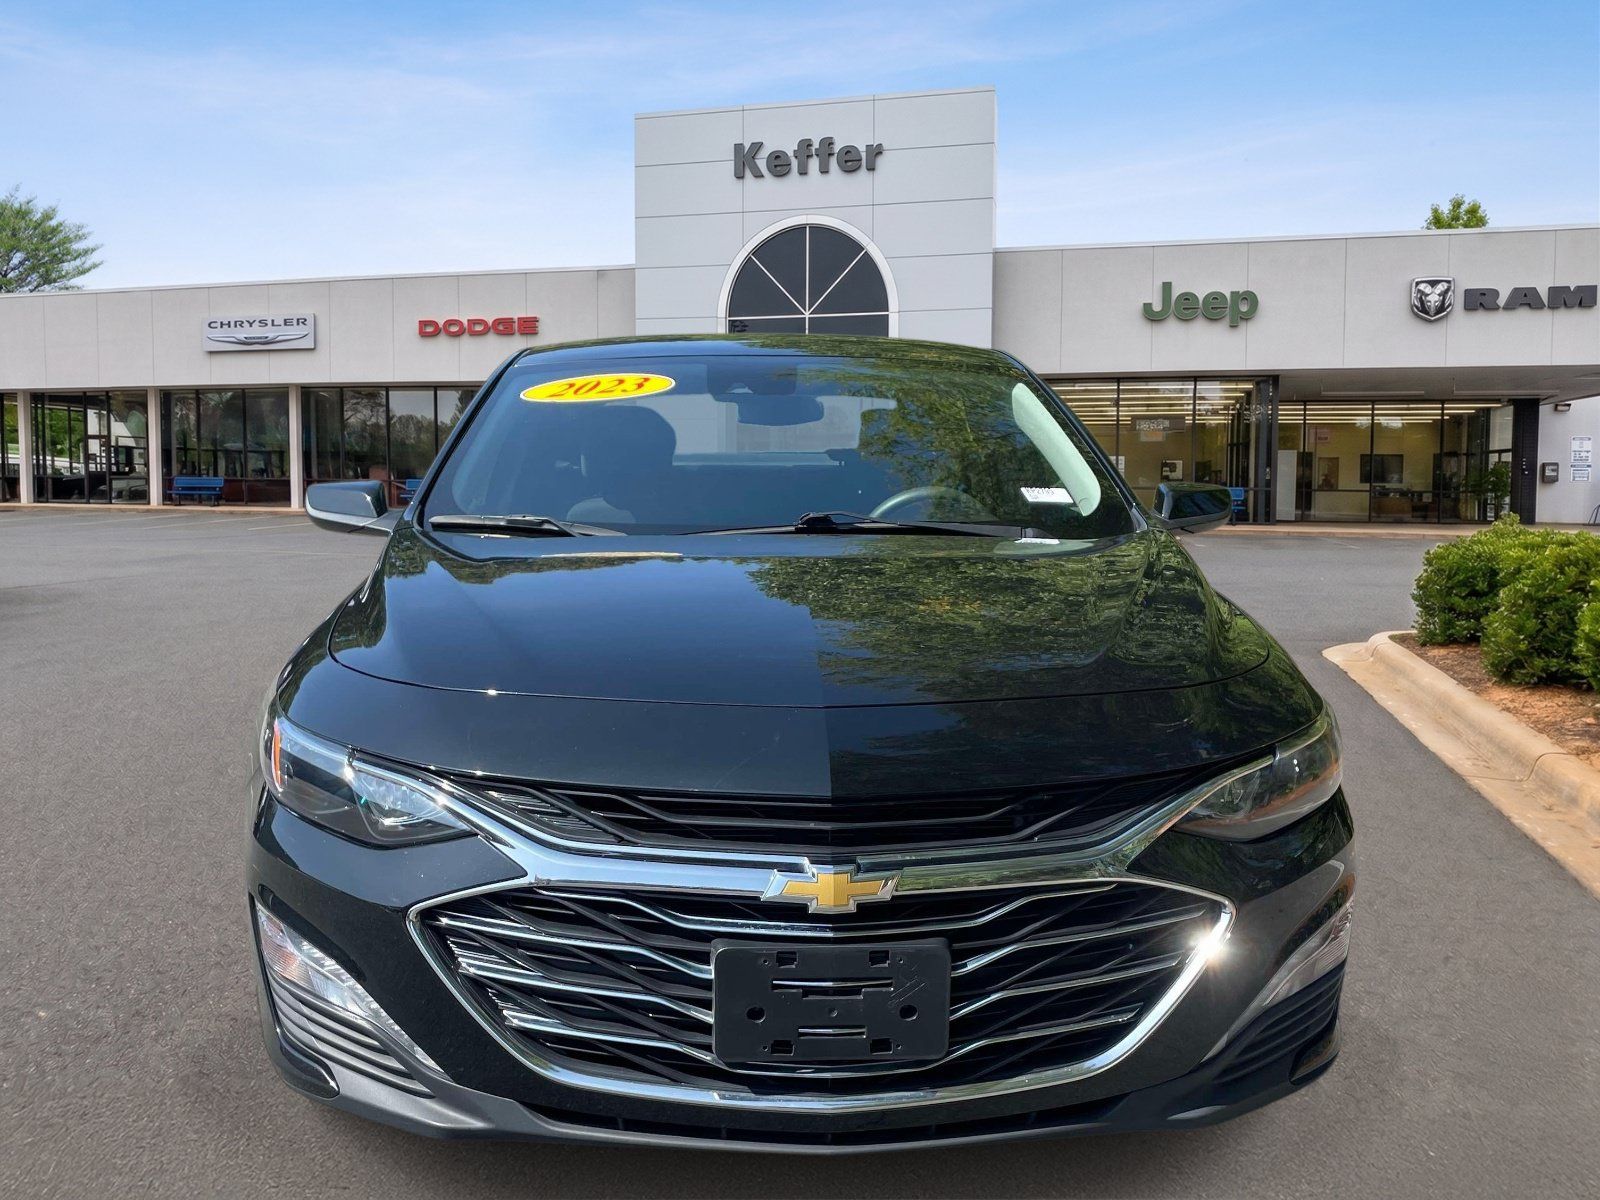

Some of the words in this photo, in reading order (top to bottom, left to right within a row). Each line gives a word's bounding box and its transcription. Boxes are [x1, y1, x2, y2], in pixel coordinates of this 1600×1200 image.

[733, 137, 884, 179] Keffer
[1142, 281, 1259, 328] Jeep
[1464, 285, 1598, 311] RAM
[207, 317, 308, 330] CHRYSLER
[418, 316, 539, 337] DODGE
[547, 377, 651, 398] 2023
